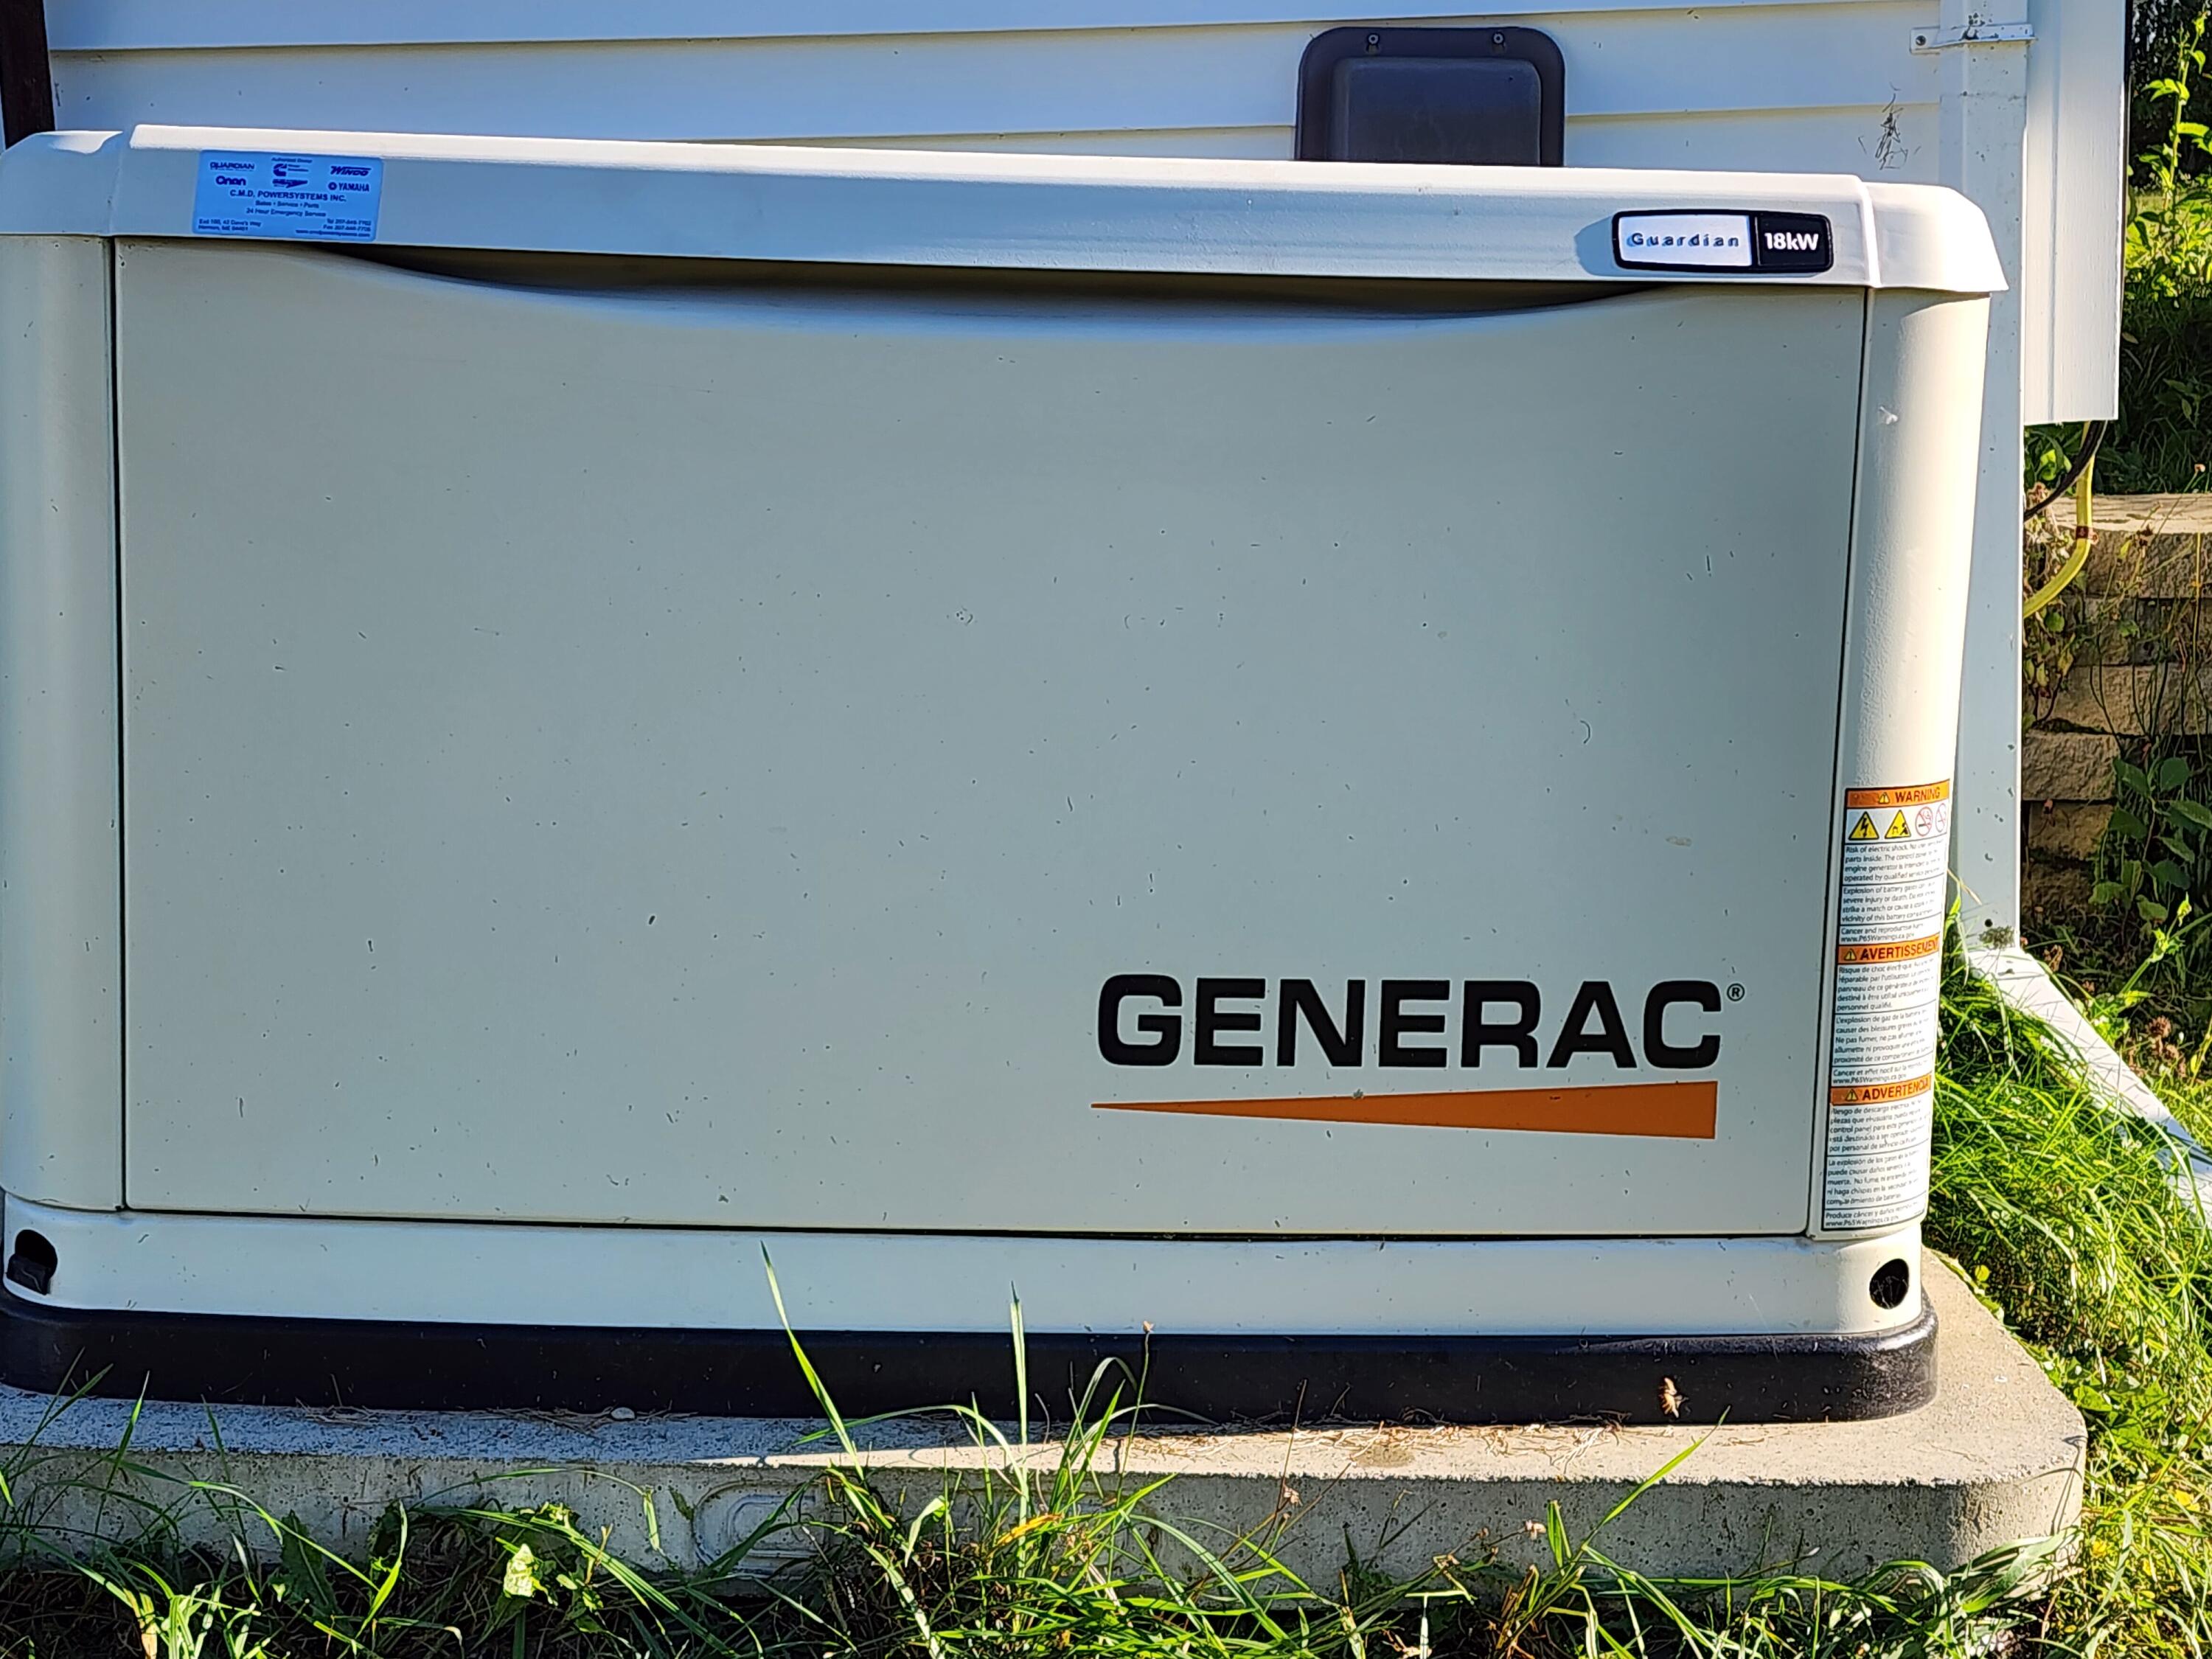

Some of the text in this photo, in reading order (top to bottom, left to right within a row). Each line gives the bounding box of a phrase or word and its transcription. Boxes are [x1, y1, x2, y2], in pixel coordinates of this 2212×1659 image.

[216, 175, 246, 186] Onan
[338, 182, 369, 192] YAMAHA
[257, 190, 328, 201] POWERSYSTEMS
[330, 194, 347, 202] INC.
[1630, 232, 1739, 247] Guardian
[1764, 231, 1819, 251] 18kW
[1895, 786, 1941, 804] WARNING
[1845, 855, 1862, 864] parts
[1845, 866, 1867, 874] engine
[1868, 864, 1898, 873] generator
[1844, 874, 1874, 883] operated
[1875, 874, 1882, 882] by
[1843, 886, 1874, 896] Explosion
[1875, 886, 1882, 894] of
[1865, 896, 1884, 905] injury
[1866, 905, 1885, 913] match
[1842, 916, 1865, 924] vicinity
[1865, 914, 1874, 922] of
[1840, 928, 1864, 936] Cancer
[1839, 966, 1860, 975] Risque
[1838, 975, 1879, 984] réparable par
[1838, 986, 1866, 994] panneau
[1837, 993, 1861, 1002] destiné
[1837, 1003, 1869, 1012] personnel
[1097, 973, 1722, 1070] GENERAC
[1836, 1016, 1871, 1026] L'explosion
[1881, 1014, 1891, 1023] gaz
[1891, 1012, 1899, 1020] de
[1857, 1025, 1869, 1033] des
[1835, 1035, 1845, 1043] Ne
[1846, 1037, 1857, 1045] pas
[1834, 1046, 1865, 1054] allumette
[1834, 1055, 1864, 1064] proximité
[1865, 1054, 1874, 1062] de
[1834, 1068, 1856, 1077] Cancer
[1829, 1144, 1841, 1153] por
[1842, 1143, 1869, 1152] personal
[1828, 1168, 1848, 1177] puede
[1834, 1188, 1850, 1197] haga
[1826, 1211, 1853, 1219] Produce
